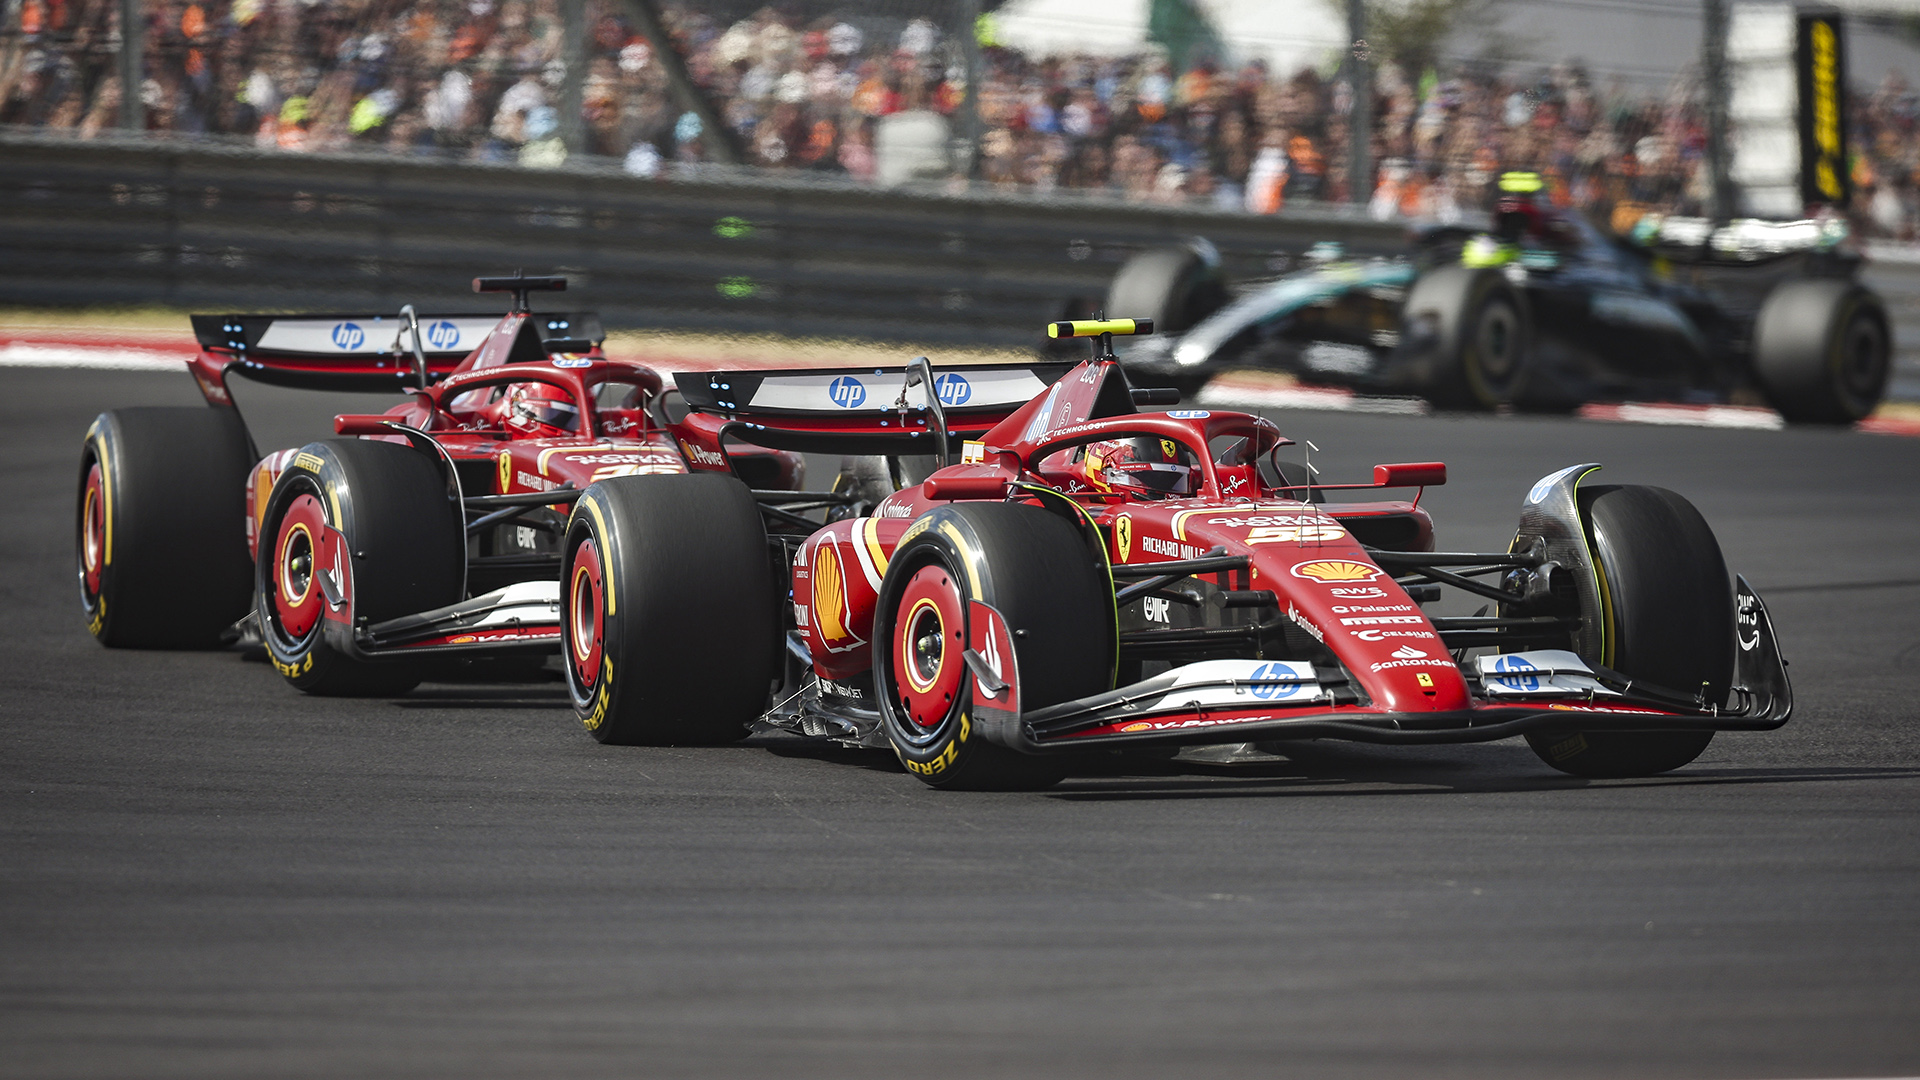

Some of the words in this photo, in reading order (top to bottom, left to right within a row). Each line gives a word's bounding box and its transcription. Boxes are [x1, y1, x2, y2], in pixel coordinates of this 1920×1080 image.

[334, 322, 364, 350] hp
[431, 321, 458, 349] hp
[834, 376, 864, 408] hp
[939, 373, 968, 405] hp
[1053, 422, 1107, 437] TECHNOLOGY
[688, 443, 725, 466] V-Power
[1207, 515, 1336, 525] GLOBAL
[1224, 519, 1334, 528] POKER
[1142, 536, 1178, 558] RICHARD
[1244, 526, 1346, 546] 55
[1330, 586, 1384, 598] aws
[1351, 605, 1413, 613] Palantir
[1339, 616, 1424, 626] PIRELLI
[1383, 630, 1435, 638] CELSIUS
[604, 653, 614, 685] P
[1370, 658, 1457, 673] Santander
[1252, 663, 1298, 699] hp
[583, 682, 610, 731] ZERO
[960, 712, 971, 743] P
[1154, 715, 1271, 730] V-Power
[906, 739, 959, 775] ZERO
